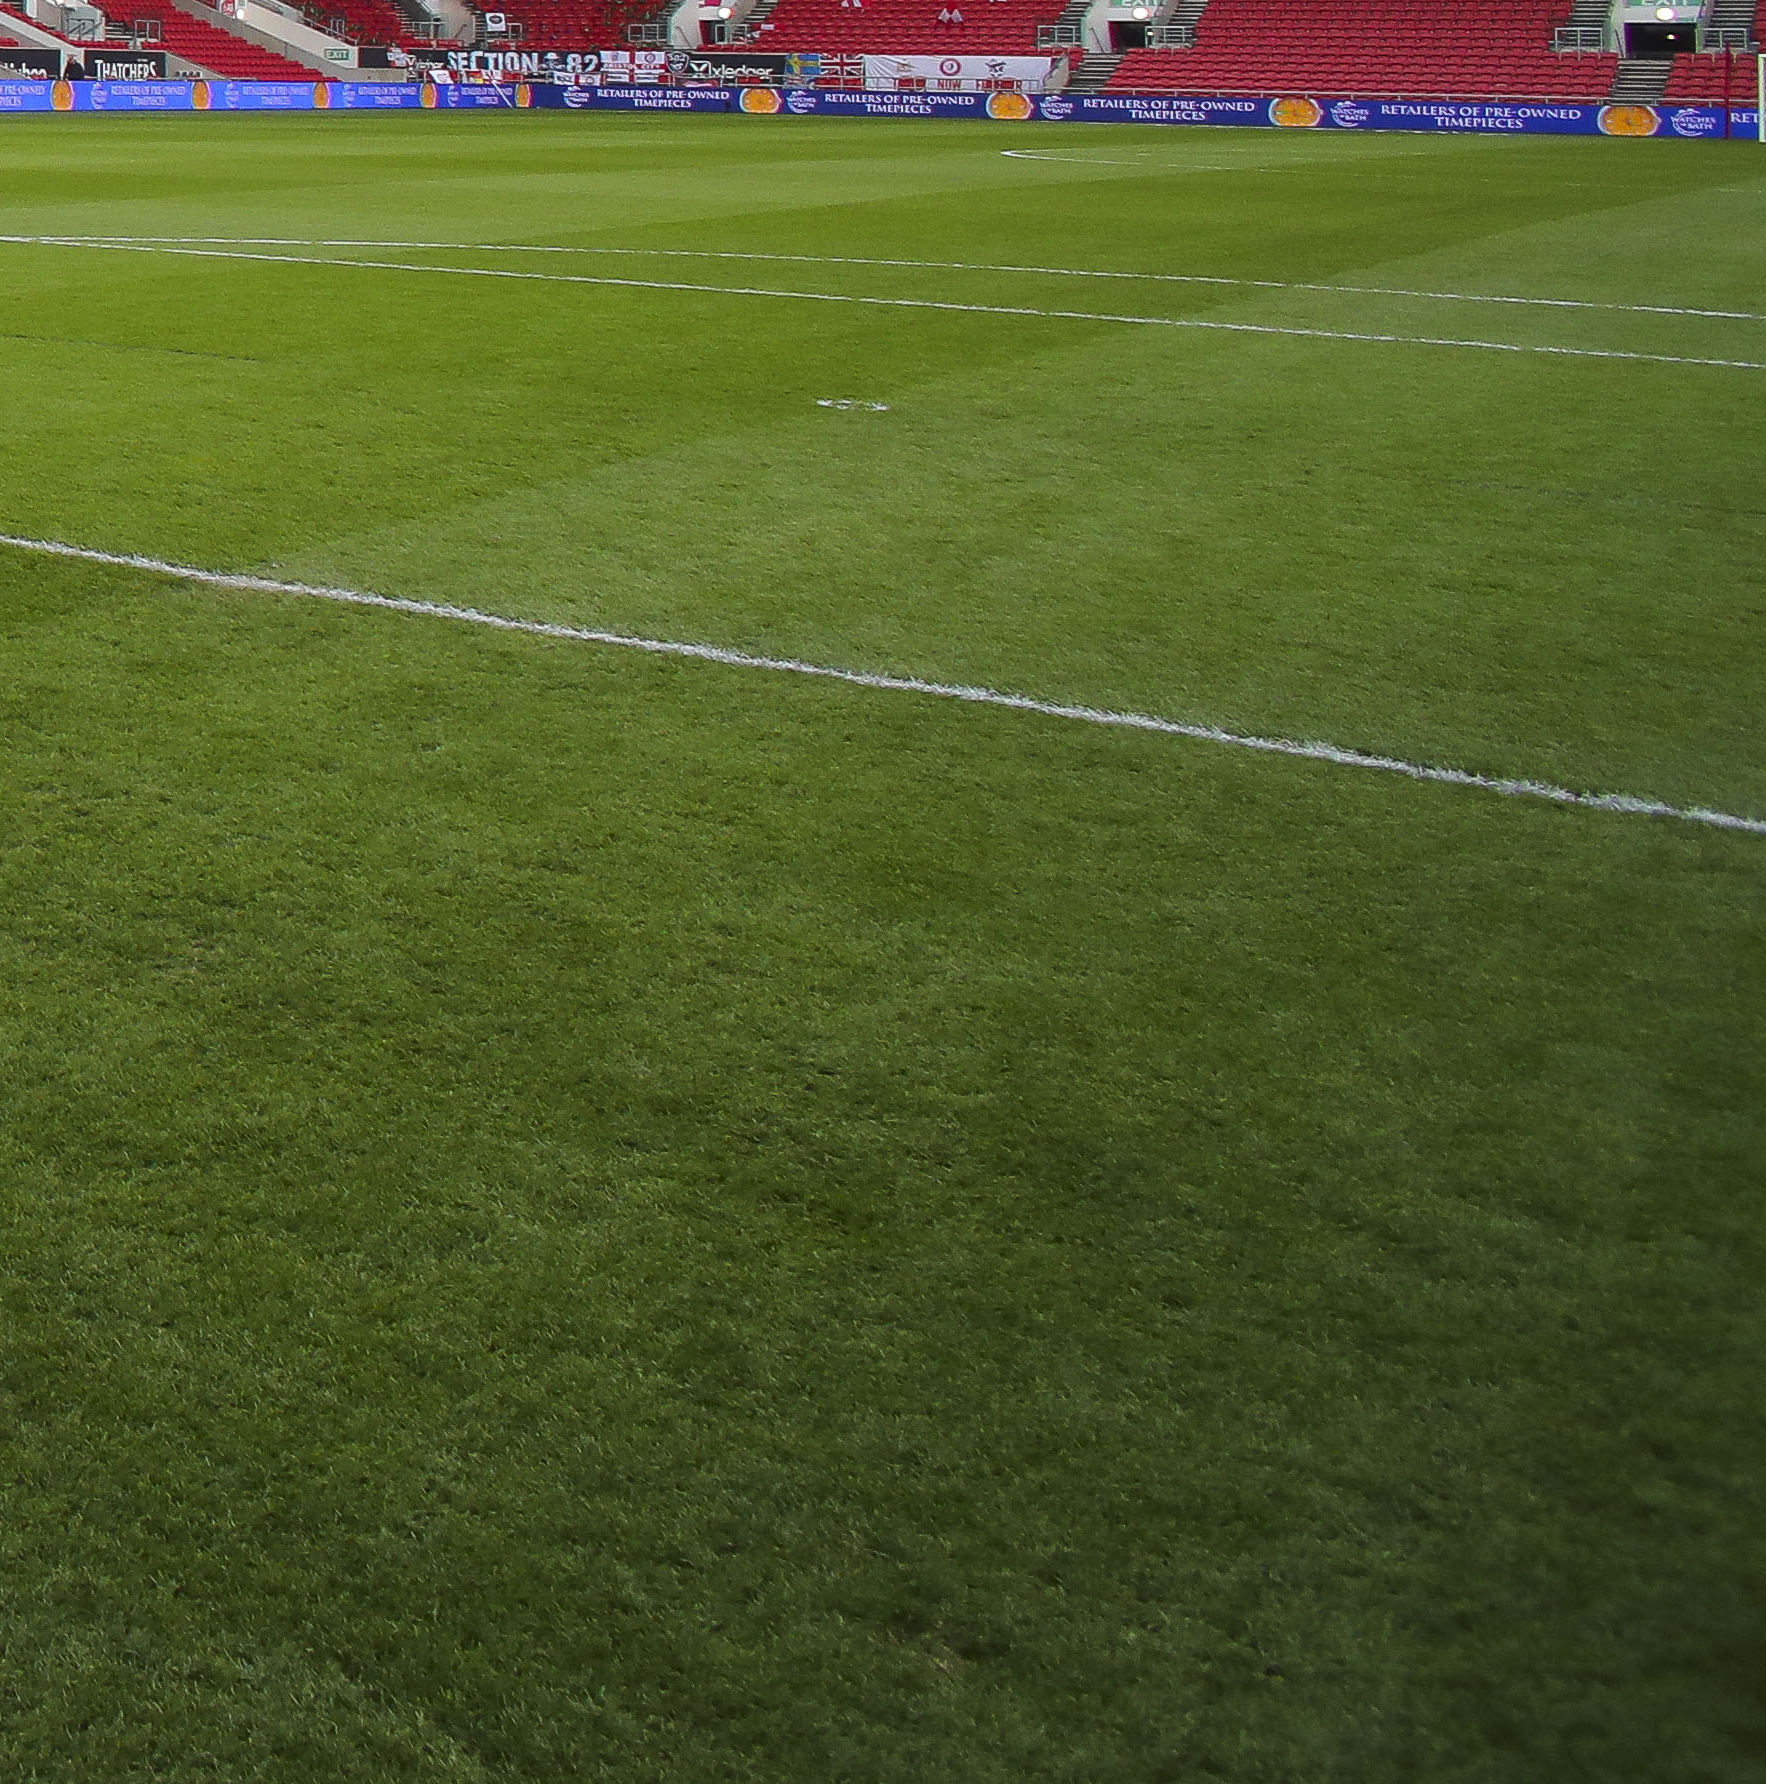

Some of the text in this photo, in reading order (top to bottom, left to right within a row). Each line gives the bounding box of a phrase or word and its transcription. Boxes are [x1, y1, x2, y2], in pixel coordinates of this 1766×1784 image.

[326, 50, 347, 59] EXIT
[447, 51, 539, 71] SECTION
[566, 53, 599, 73] 82
[95, 60, 157, 81] THATCHERS
[711, 65, 772, 78] xledger
[597, 89, 730, 100] RETAILERS OF PRE-OWNED
[825, 93, 974, 105] RETAILERS OF PRE-OWNED
[633, 99, 692, 108] TIMEPIECES
[865, 104, 931, 113] TIMEPIECES
[1083, 98, 1255, 111] RETAILERS OF PRE-OWNED
[1129, 109, 1205, 120] TIMEPIECES
[1381, 105, 1581, 120] RETAILERS OF PRE-OWNED
[1435, 117, 1523, 128] TIMEPIECES
